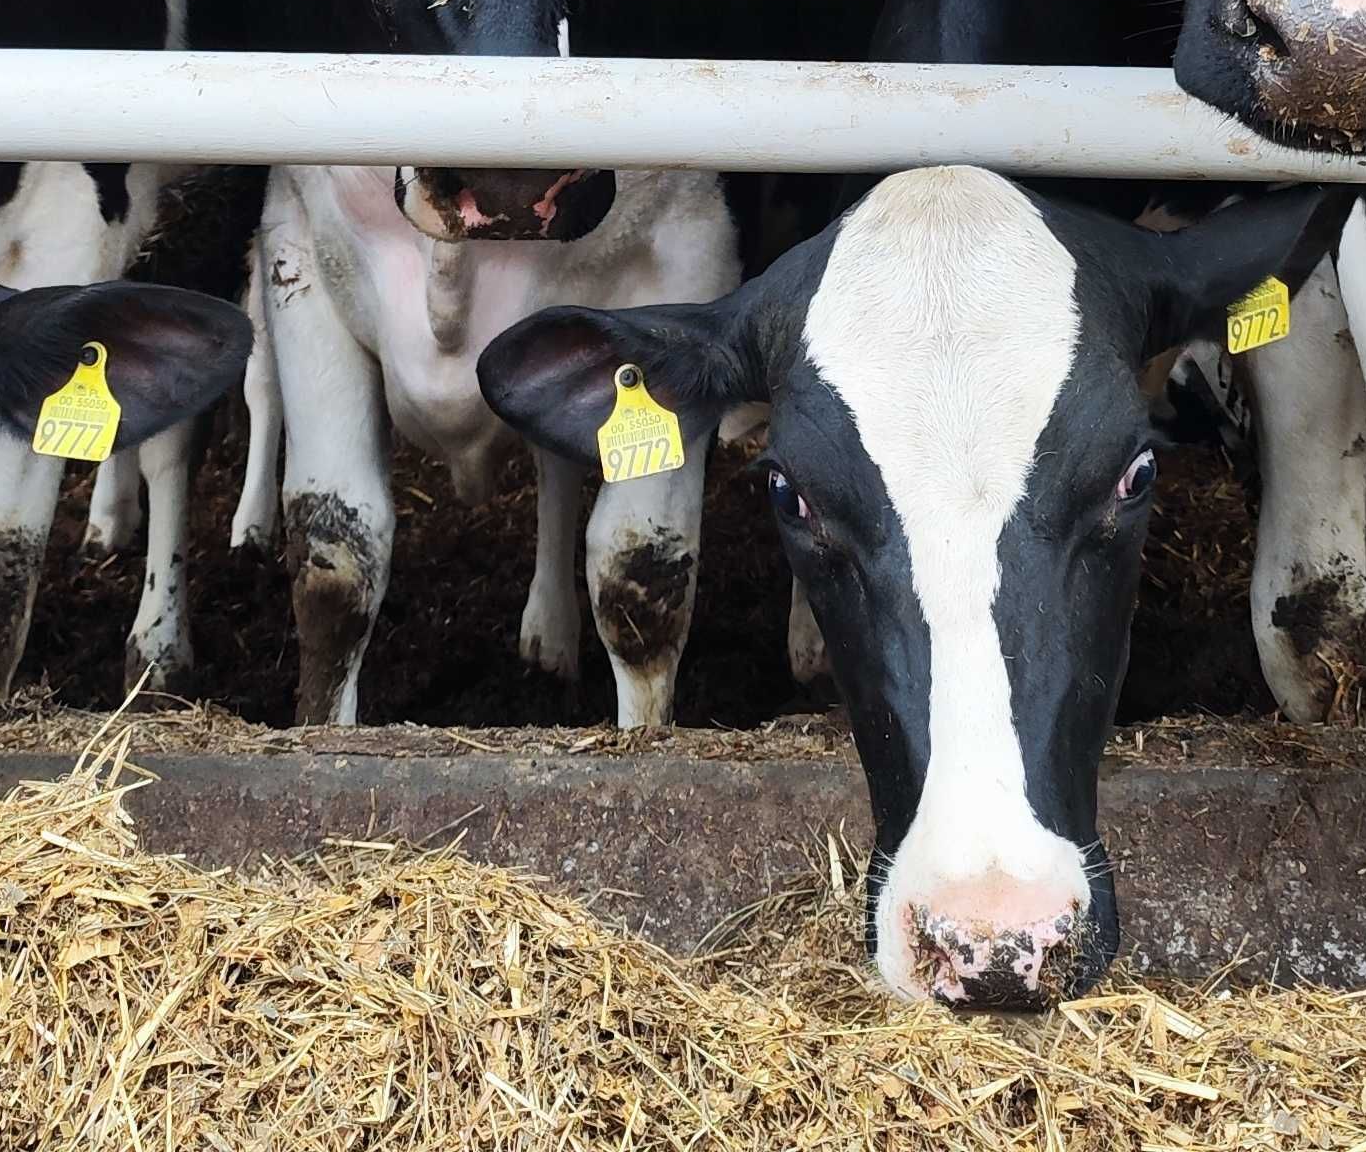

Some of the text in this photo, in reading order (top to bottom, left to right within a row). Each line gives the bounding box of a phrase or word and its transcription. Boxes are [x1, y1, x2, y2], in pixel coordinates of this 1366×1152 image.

[1232, 307, 1280, 351] 9772
[39, 419, 103, 457] 9777
[608, 437, 673, 481] 9772
